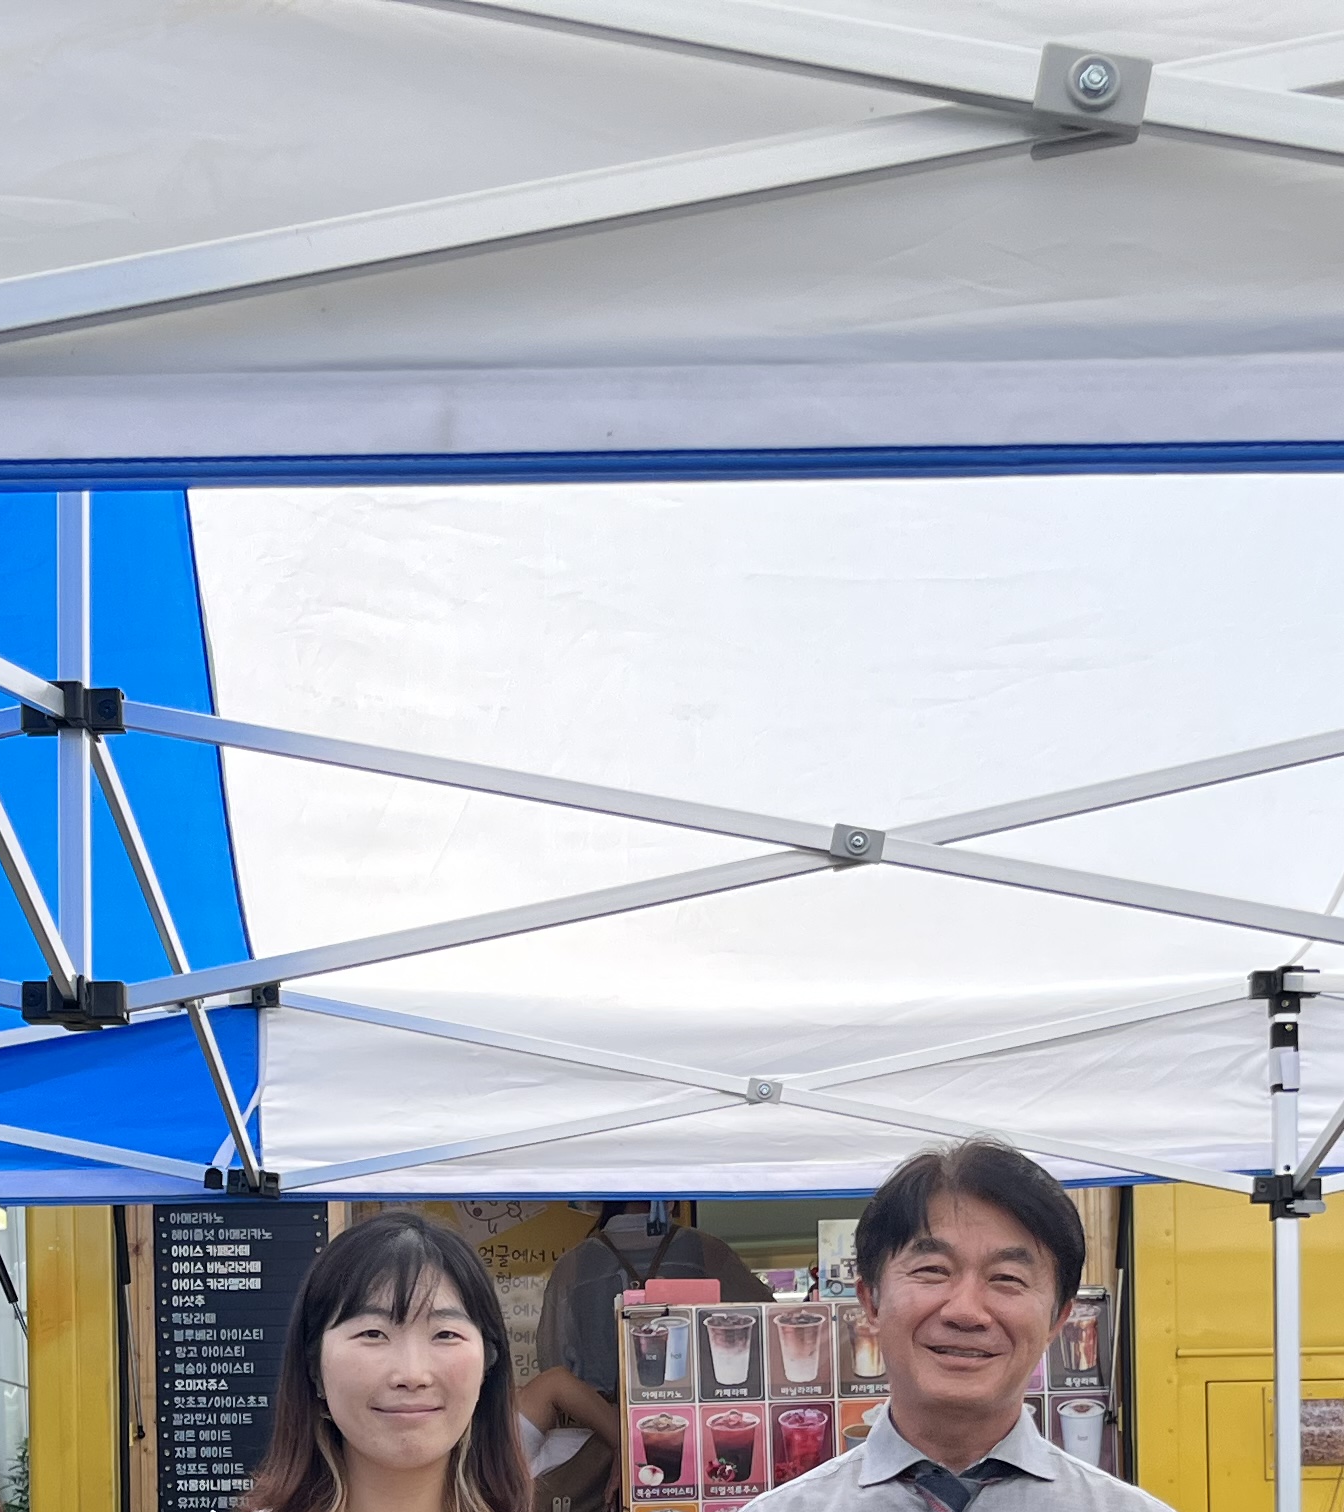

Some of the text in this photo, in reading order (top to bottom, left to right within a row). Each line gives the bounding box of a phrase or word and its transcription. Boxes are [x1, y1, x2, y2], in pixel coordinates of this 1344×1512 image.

[170, 1212, 224, 1224] 아메리카노
[171, 1228, 273, 1241] 헤이즐넛 아메리카노
[171, 1244, 251, 1257] 아이스 카페라떼
[478, 1245, 545, 1268] 얼굴에서
[172, 1261, 262, 1274] 아이스 바닐라라떼
[172, 1278, 262, 1291] 아이스 카라멜라떼
[172, 1312, 216, 1325] 흑당라떼
[174, 1328, 264, 1341] 블루베리 아이스티
[175, 1345, 245, 1358] 망고 아이스티
[174, 1362, 254, 1375] 복숭아 아이스티
[172, 1413, 253, 1425] 깔라만시 에이드
[174, 1430, 232, 1442] 레몬 에이드
[174, 1446, 233, 1459] 자몽 에이드
[175, 1463, 245, 1475] 청포도 에이드
